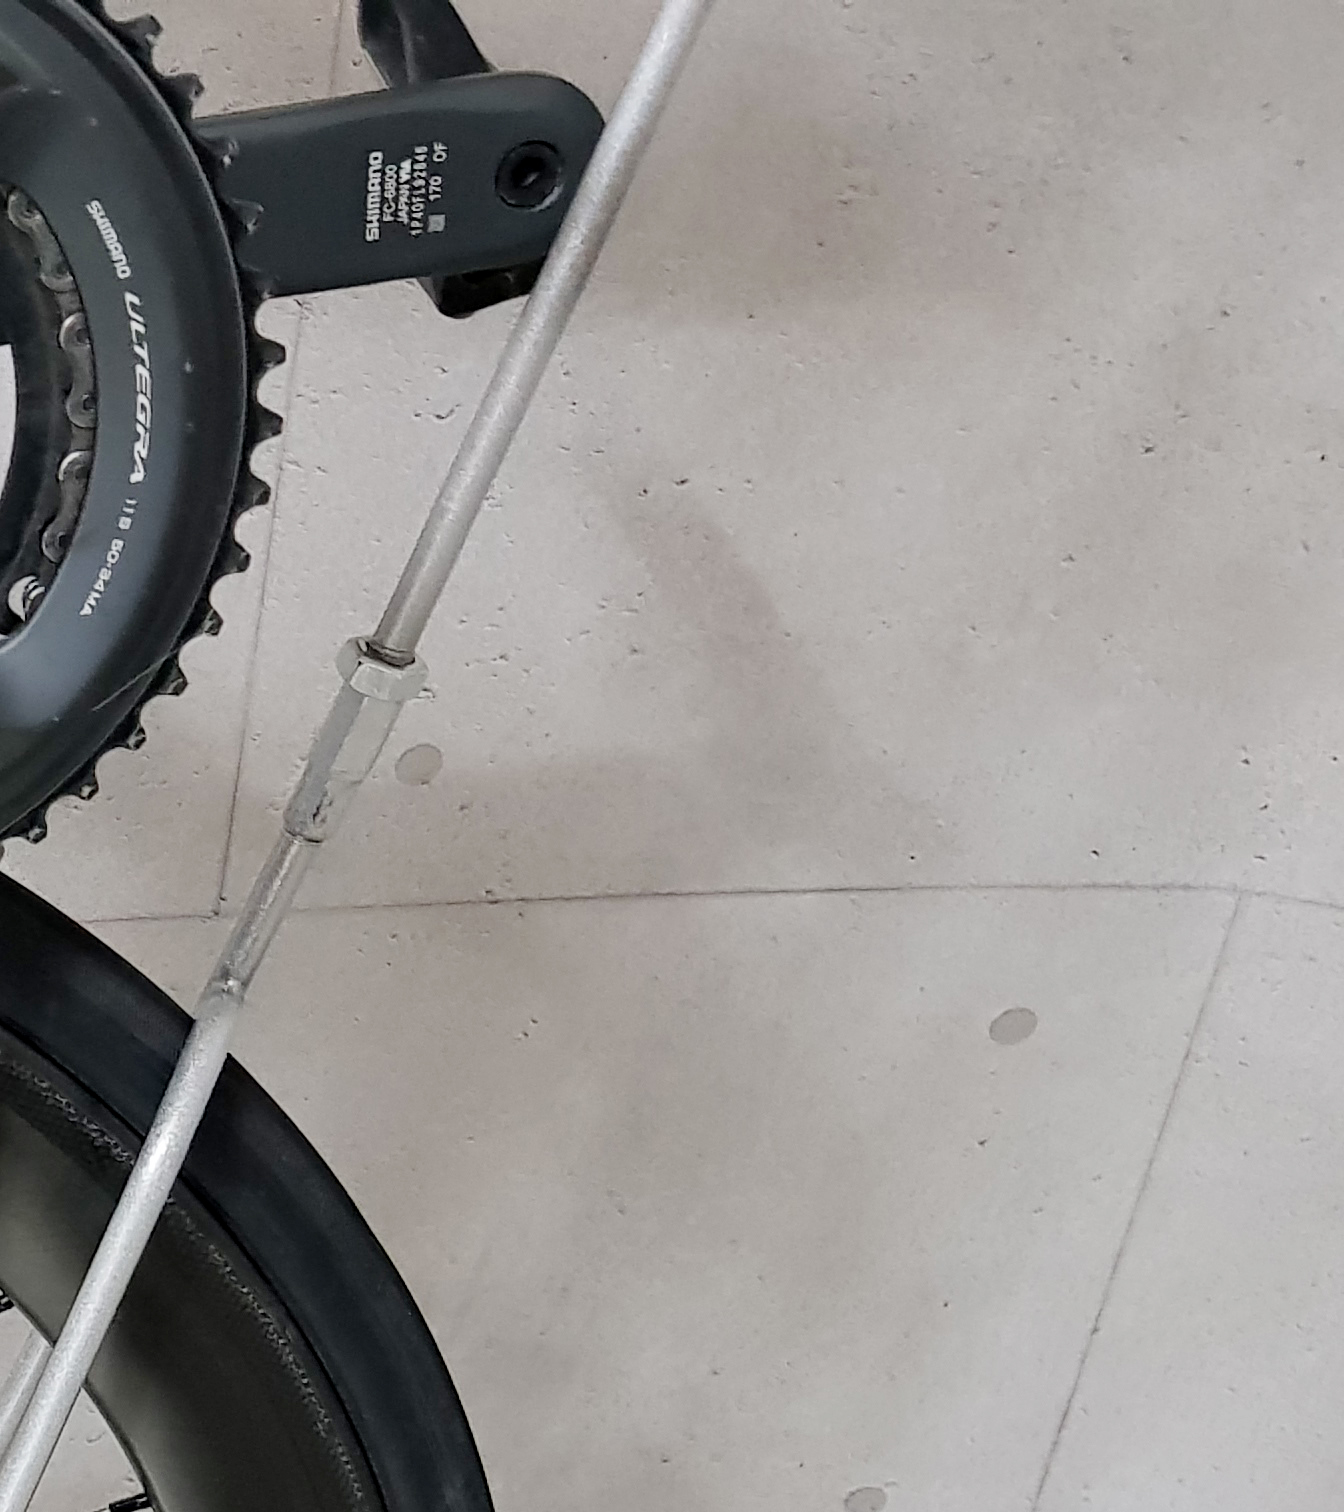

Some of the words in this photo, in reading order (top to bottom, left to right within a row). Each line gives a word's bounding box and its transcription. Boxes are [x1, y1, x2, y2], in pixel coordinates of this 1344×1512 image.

[365, 151, 383, 242] SHIMANO
[383, 164, 397, 222] FC-6800
[428, 175, 442, 202] 170
[85, 199, 132, 280] SHIMANO
[123, 291, 153, 484] ULTEGRA
